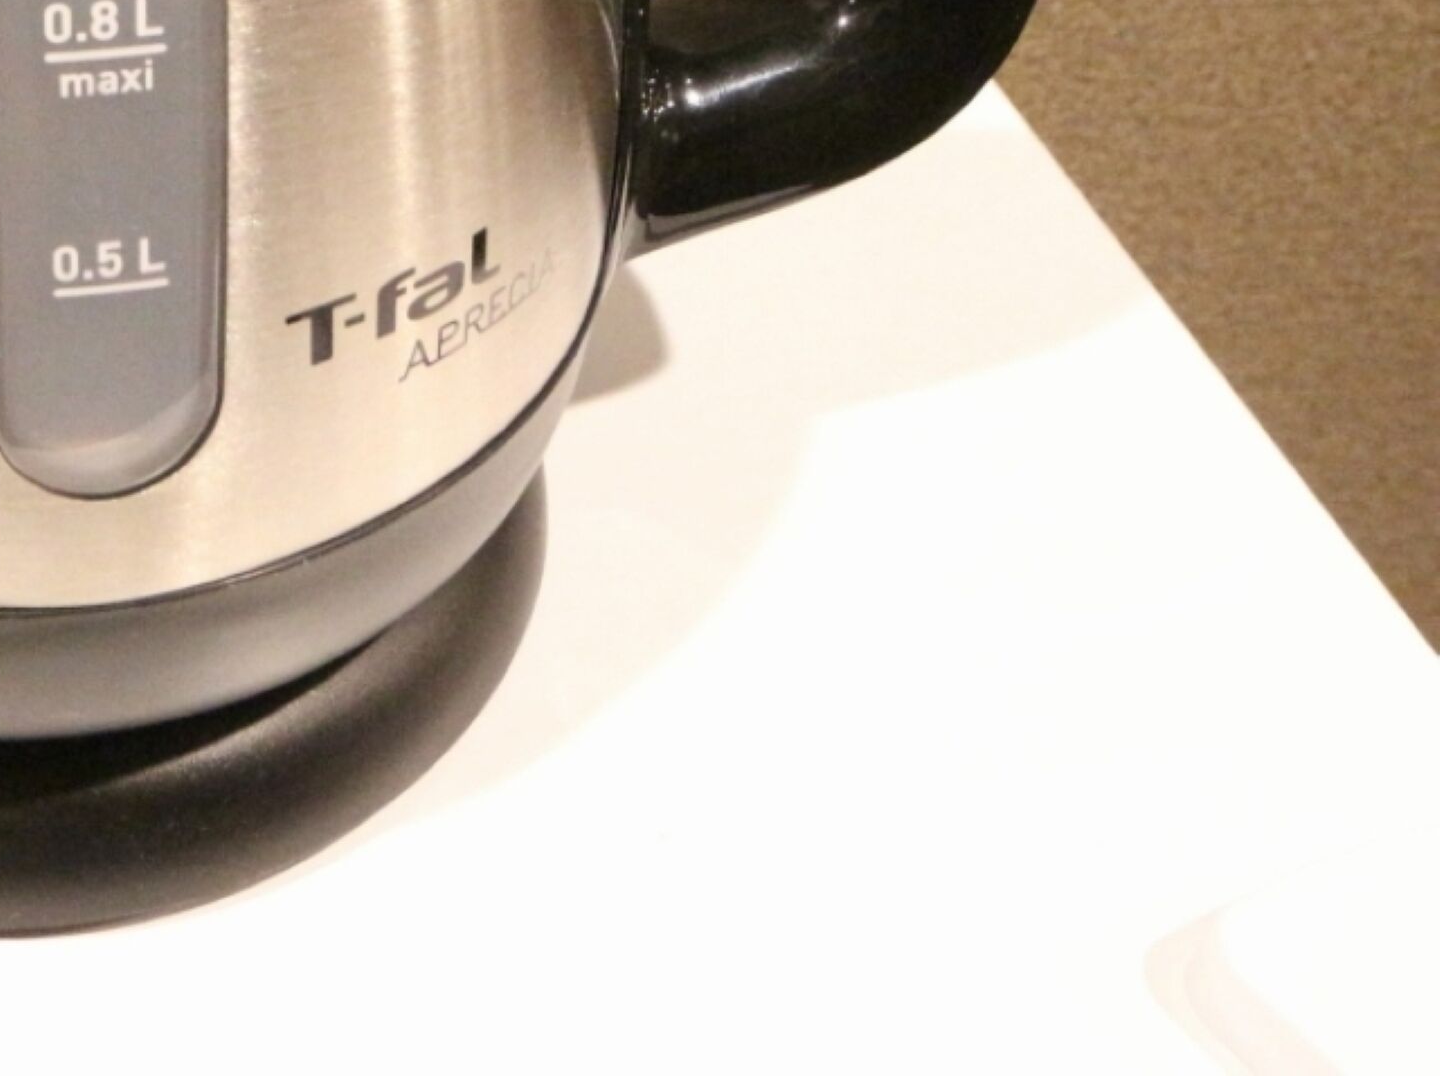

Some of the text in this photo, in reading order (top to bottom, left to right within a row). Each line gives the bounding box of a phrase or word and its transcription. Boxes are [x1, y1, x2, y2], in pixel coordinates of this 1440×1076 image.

[43, 0, 119, 44] 0.8
[60, 59, 154, 99] maxi
[52, 236, 167, 283] 0.5 L
[285, 227, 502, 366] T-fal
[398, 246, 558, 383] APRECIA
